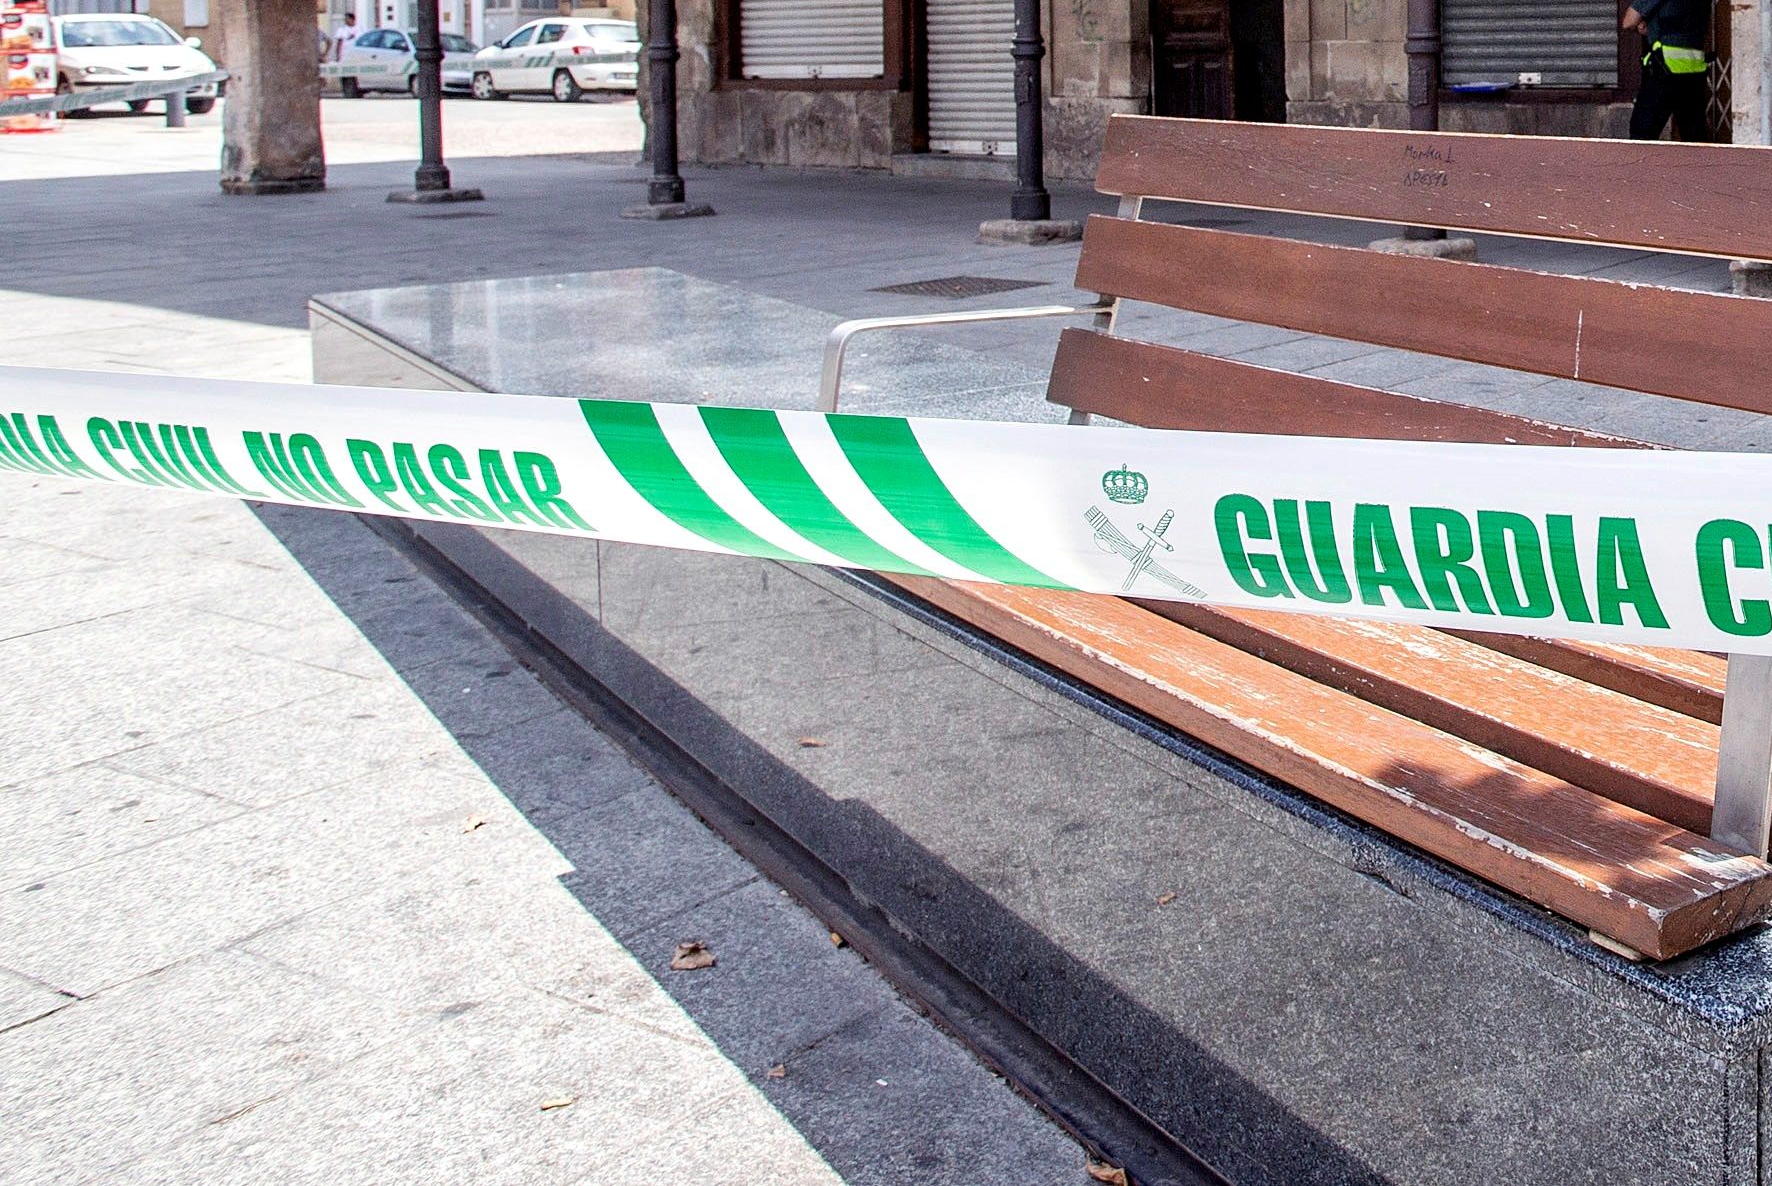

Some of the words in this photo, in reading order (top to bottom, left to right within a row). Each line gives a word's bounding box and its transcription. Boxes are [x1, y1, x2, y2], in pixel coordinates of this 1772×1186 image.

[86, 416, 270, 498] CIVIL
[242, 431, 365, 508] NO
[345, 438, 600, 532] PASAR
[1214, 493, 1671, 629] GUARDIA
